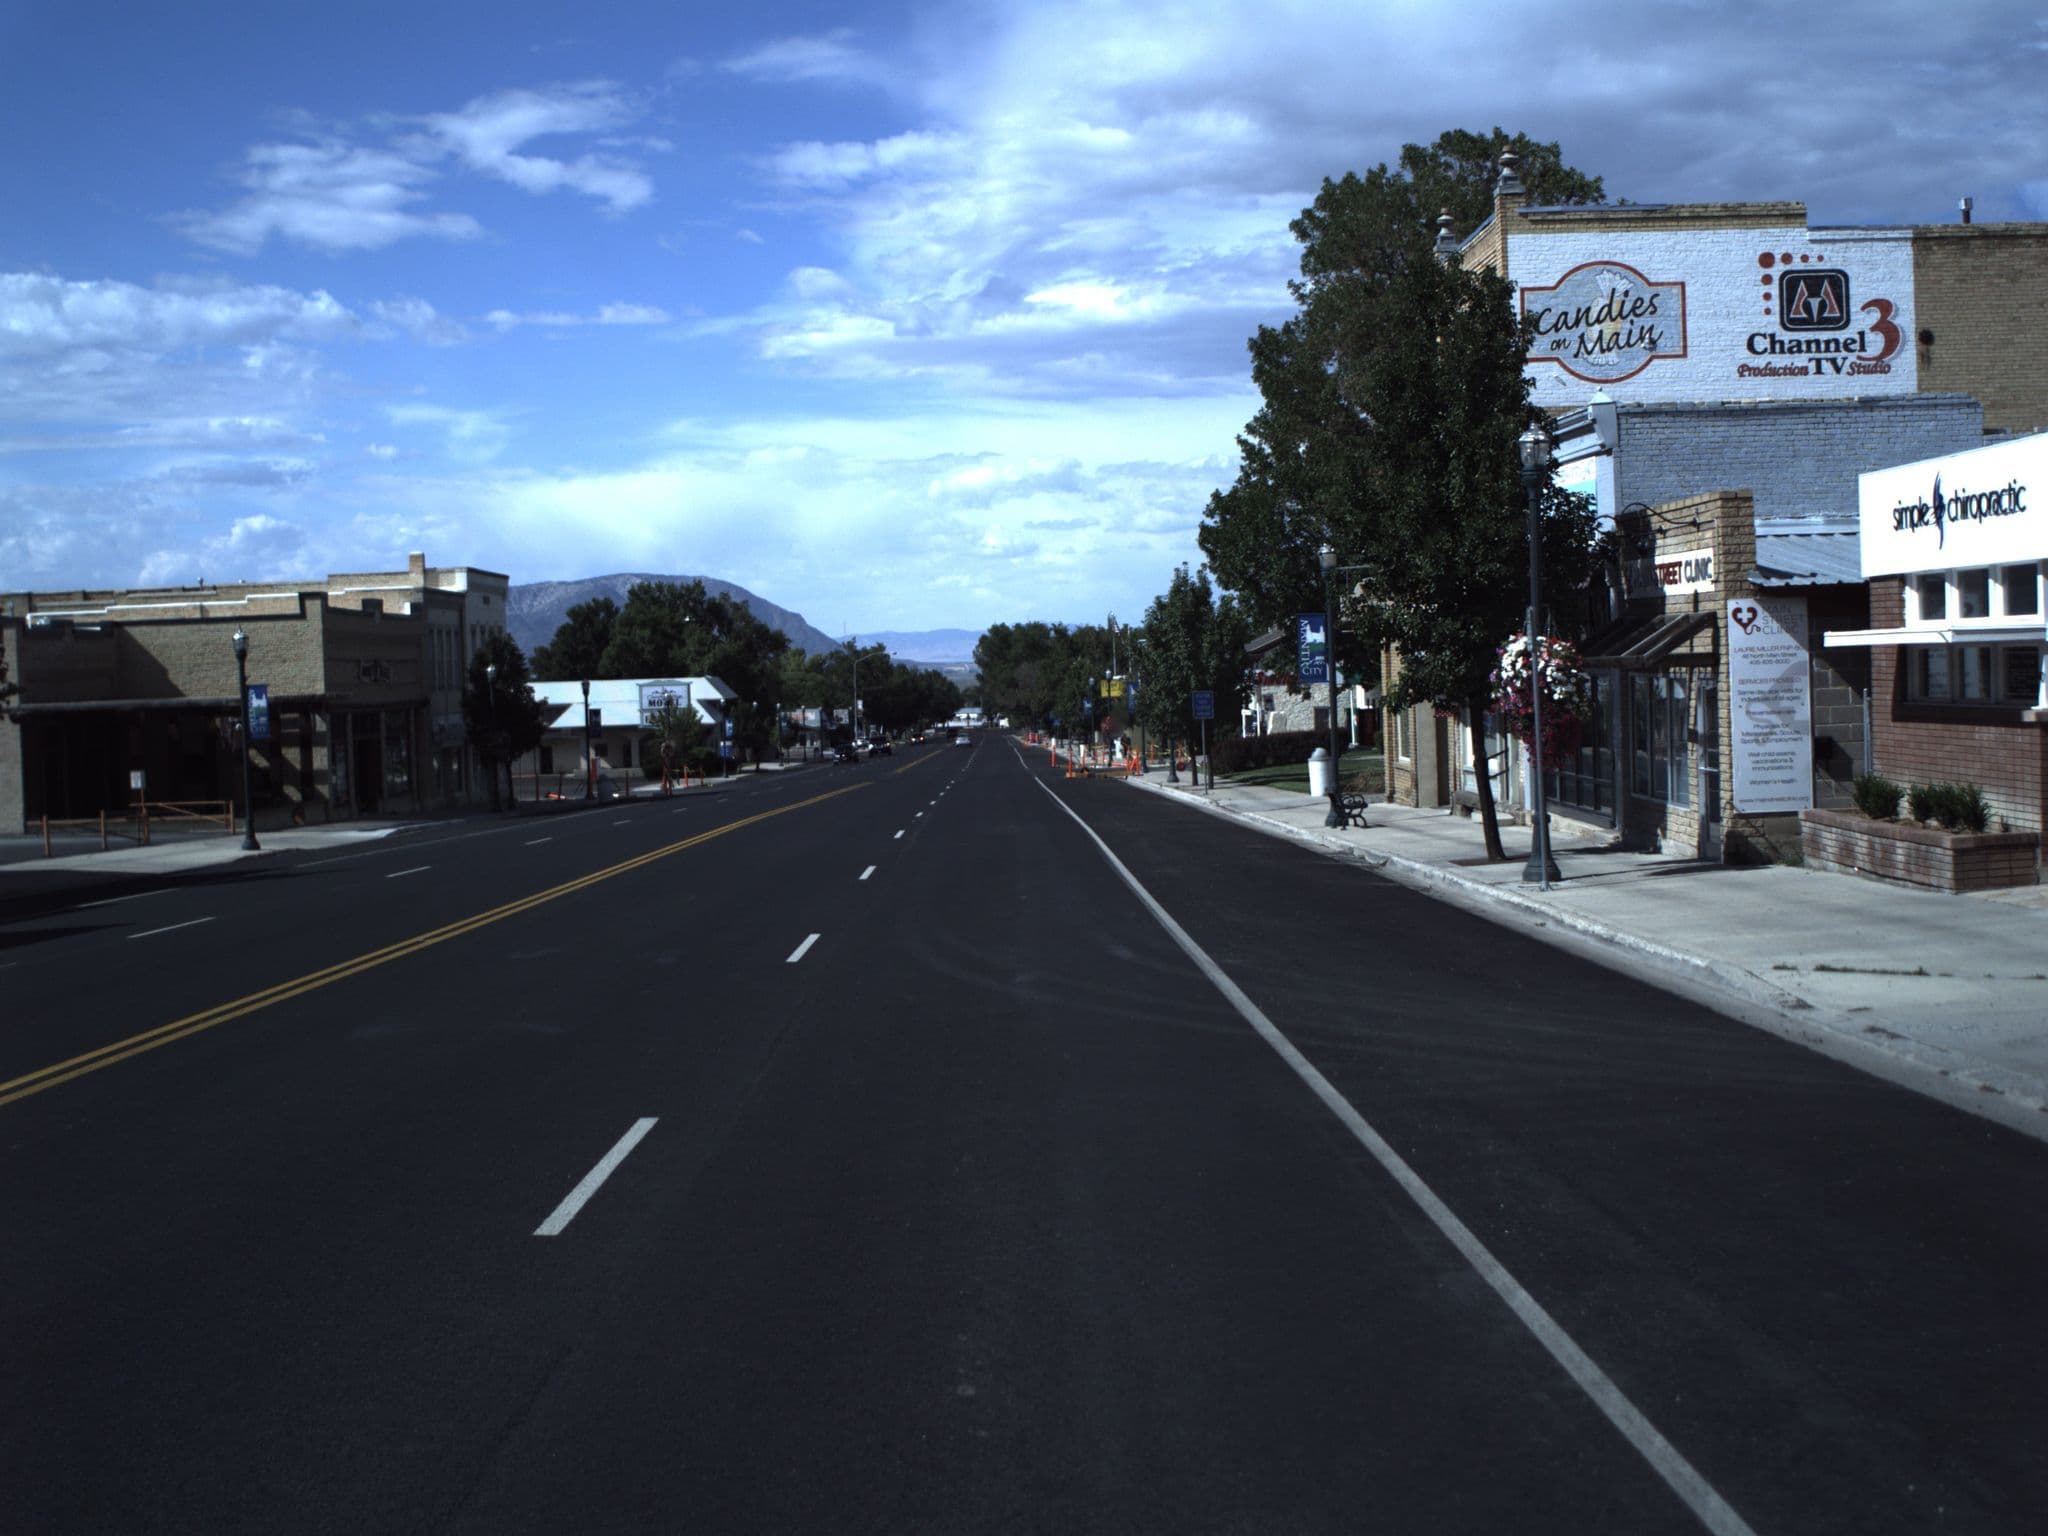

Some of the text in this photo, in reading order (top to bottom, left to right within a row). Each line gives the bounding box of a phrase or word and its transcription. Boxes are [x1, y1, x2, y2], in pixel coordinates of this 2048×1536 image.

[1535, 287, 1661, 337] Candies
[1550, 318, 1664, 359] on Main
[1746, 298, 1902, 363] Channel 3
[1737, 356, 1892, 378] Production TV Studio
[1893, 478, 2026, 533] simple chiropractic
[1655, 556, 1713, 586] TREET CLINIC
[1762, 624, 1800, 635] CLINIC
[1302, 667, 1323, 676] CITY
[648, 698, 682, 707] MOL
